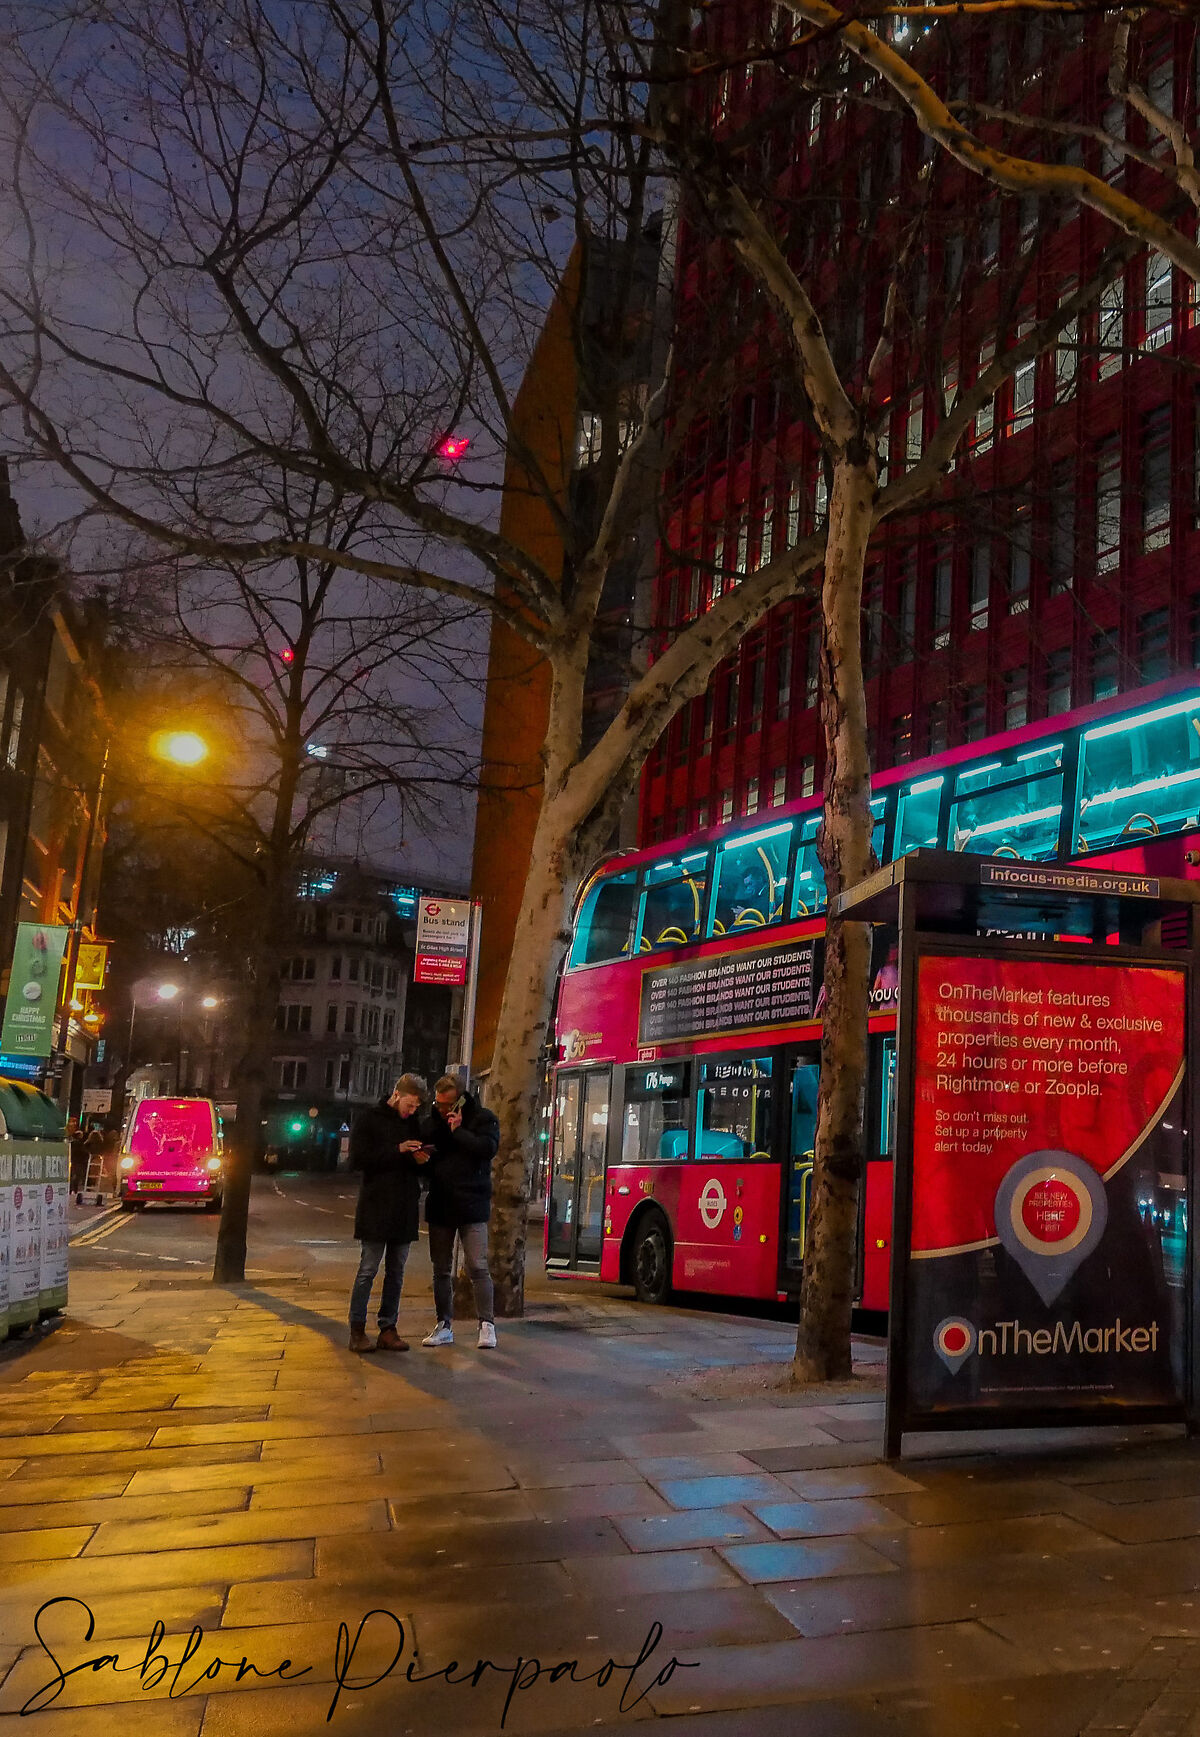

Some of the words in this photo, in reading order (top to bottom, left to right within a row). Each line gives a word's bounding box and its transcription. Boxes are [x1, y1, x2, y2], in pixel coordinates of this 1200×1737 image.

[990, 868, 1150, 893] infocus-media.org.uk
[423, 916, 439, 924] Bus
[441, 918, 466, 927] stand
[651, 978, 667, 989] OVER
[679, 970, 707, 983] FASHION
[707, 964, 735, 978] BRANDS
[736, 960, 756, 971] WANT
[757, 956, 772, 967] OUR
[651, 990, 667, 1001] OVER
[678, 983, 706, 995] FASHION
[706, 977, 734, 991] BRANDS
[735, 973, 756, 984] WANT
[756, 970, 771, 980] OUR
[869, 987, 892, 1003] YOU
[939, 983, 1043, 1005] OnTheMarket
[1047, 989, 1110, 1007] features
[650, 1002, 666, 1012] OVER
[677, 995, 705, 1008] FASHION
[706, 990, 734, 1003] BRANDS
[734, 986, 755, 997] WANT
[755, 982, 771, 993] OUR
[705, 1003, 733, 1016] BRANDS
[734, 999, 755, 1010] WANT
[755, 996, 770, 1006] OUR
[11, 1013, 47, 1024] CHRISTMAS
[20, 1006, 40, 1015] HAPPY
[705, 1015, 733, 1028] BRANDS
[733, 1012, 754, 1023] WANT
[754, 1009, 770, 1020] OUR
[938, 1007, 1019, 1026] thousands
[1023, 1011, 1038, 1026] of
[1043, 1014, 1076, 1029] new
[1080, 1013, 1092, 1028] &
[1096, 1015, 1163, 1032] exclusive
[937, 1031, 1018, 1049] properties
[1022, 1036, 1064, 1053] every
[1068, 1037, 1121, 1054] month,
[936, 1052, 957, 1068] 24
[962, 1053, 1007, 1070] hours
[1012, 1058, 1028, 1071] or
[1032, 1058, 1073, 1073] more
[1078, 1057, 1128, 1074] before
[645, 1072, 658, 1090] 176
[936, 1075, 1020, 1096] Rightmove
[1024, 1082, 1041, 1093] or
[1045, 1079, 1103, 1099] Zoopla.
[935, 1109, 950, 1121] So
[953, 1110, 980, 1122] don't
[983, 1112, 1008, 1123] miss
[1010, 1113, 1029, 1124] out.
[934, 1125, 953, 1137] Set
[955, 1128, 970, 1139] up
[972, 1129, 980, 1137] a
[982, 1128, 1028, 1141] property
[934, 1141, 958, 1152] alert
[962, 1142, 994, 1155] today.
[1028, 1200, 1074, 1208] PROPERTIES
[1034, 1192, 1048, 1200] SEE
[1050, 1192, 1068, 1200] NEW
[1036, 1210, 1066, 1222] HERE
[935, 1316, 1159, 1362] OnTheMarket
